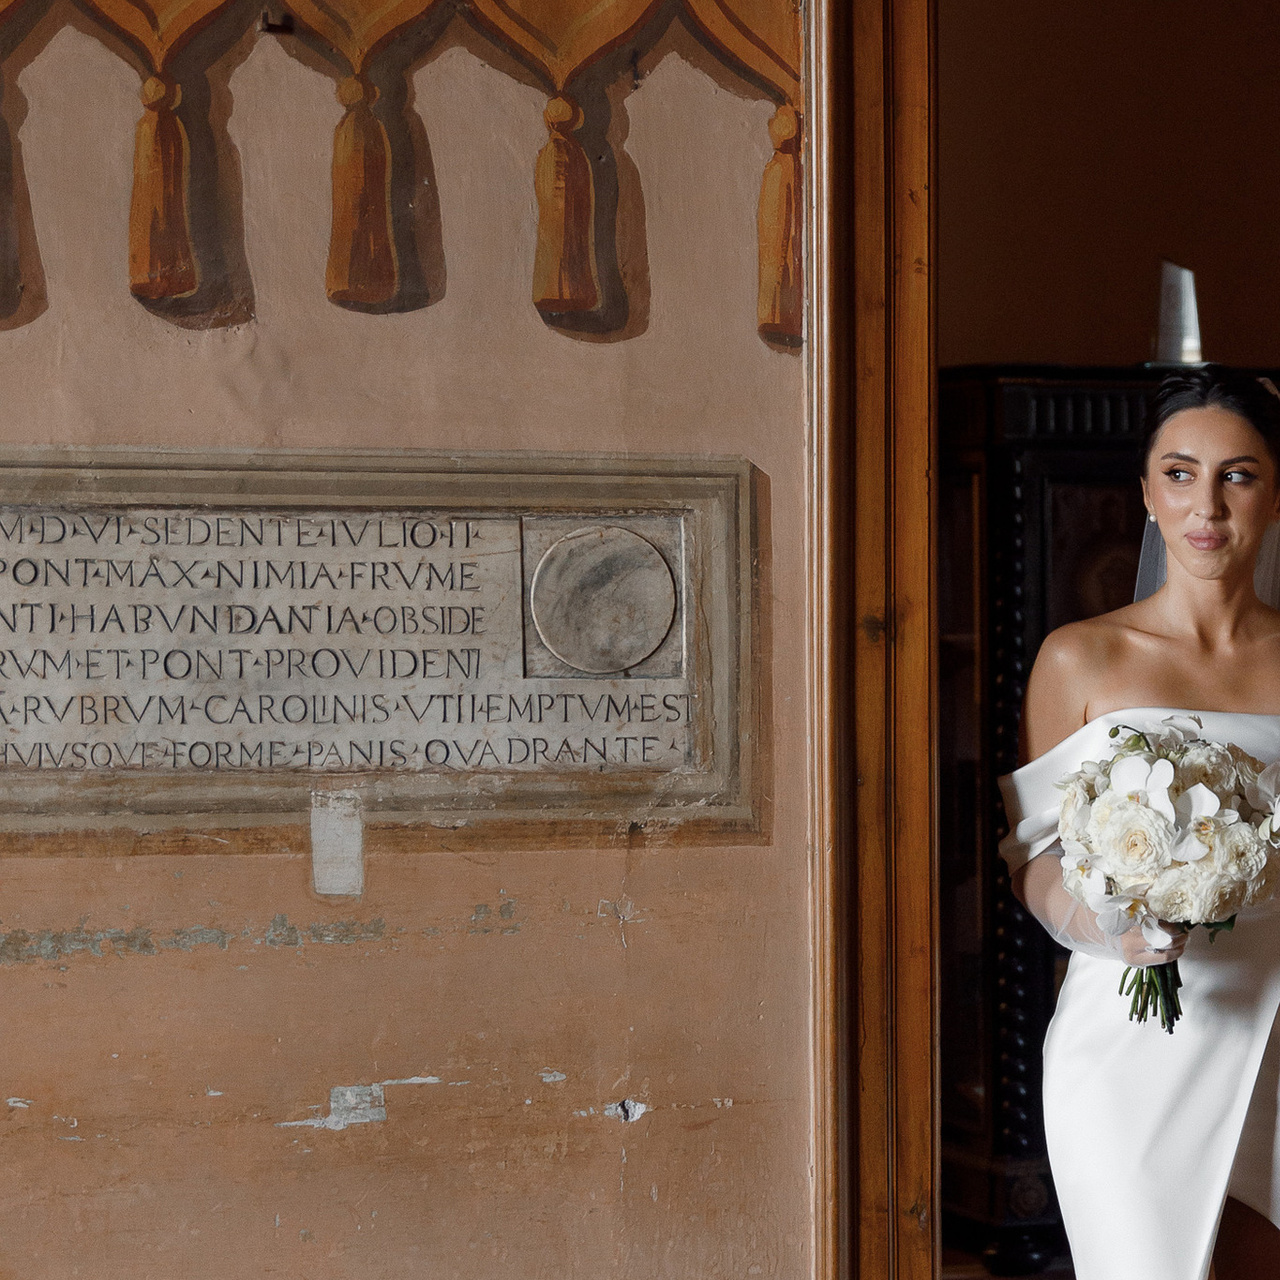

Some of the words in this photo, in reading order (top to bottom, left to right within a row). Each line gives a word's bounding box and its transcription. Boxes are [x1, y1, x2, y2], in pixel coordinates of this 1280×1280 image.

[140, 517, 318, 547] SEDENTE
[330, 519, 437, 549] IVLIO
[104, 559, 200, 589] MAX
[216, 560, 338, 590] NIMIA
[350, 562, 481, 591] FRVME
[70, 604, 364, 635] HABVNDANTIA
[373, 605, 486, 635] OBSIDE
[85, 649, 128, 680] ET
[140, 648, 253, 680] PONT
[23, 695, 188, 726] RVBRVM
[486, 694, 632, 724] EMPTVM
[640, 693, 697, 722] EST
[307, 739, 408, 767] PANIS
[424, 737, 663, 770] QVADRANTE
